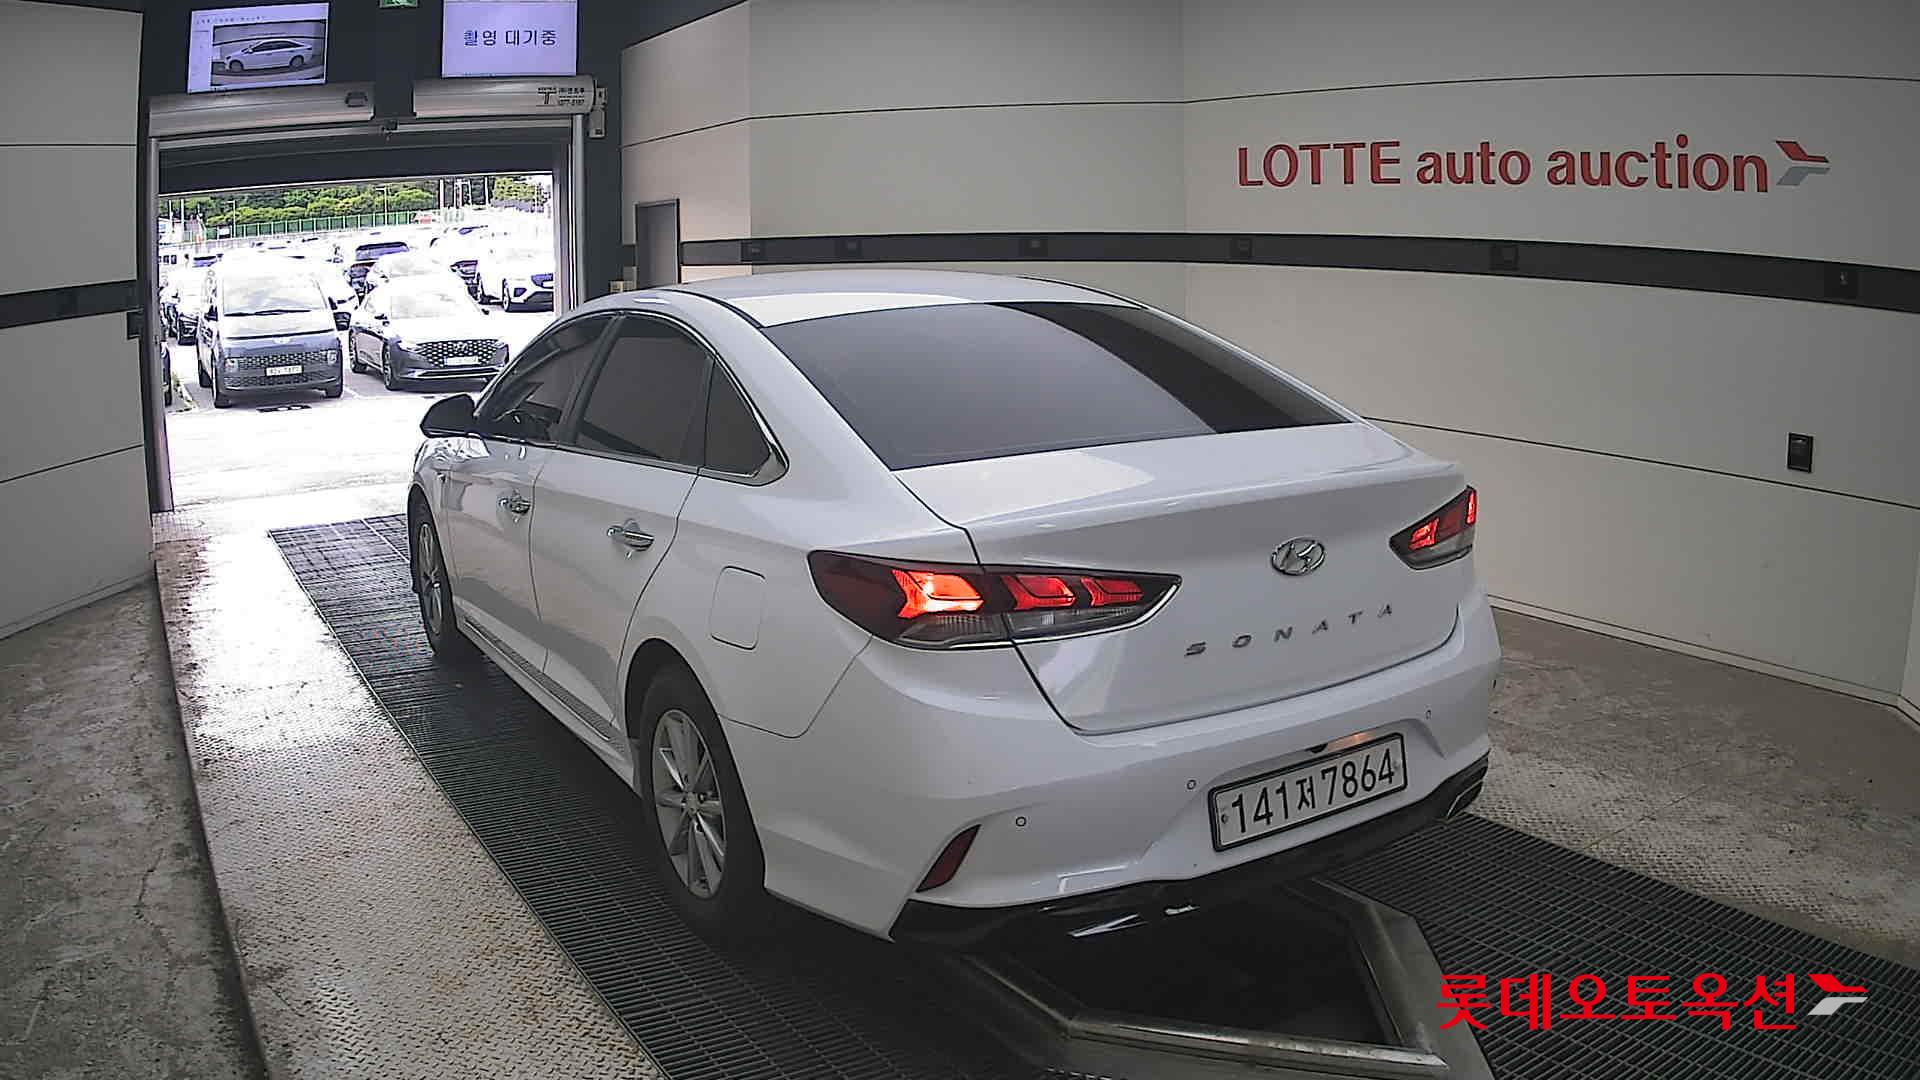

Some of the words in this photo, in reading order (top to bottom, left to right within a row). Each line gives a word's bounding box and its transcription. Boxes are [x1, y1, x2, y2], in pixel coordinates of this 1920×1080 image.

[505, 30, 557, 46] 대기중
[1238, 141, 1401, 187] LOTTE
[1416, 141, 1532, 186] auto
[1546, 134, 1769, 193] auction
[1184, 604, 1393, 658] SONATA
